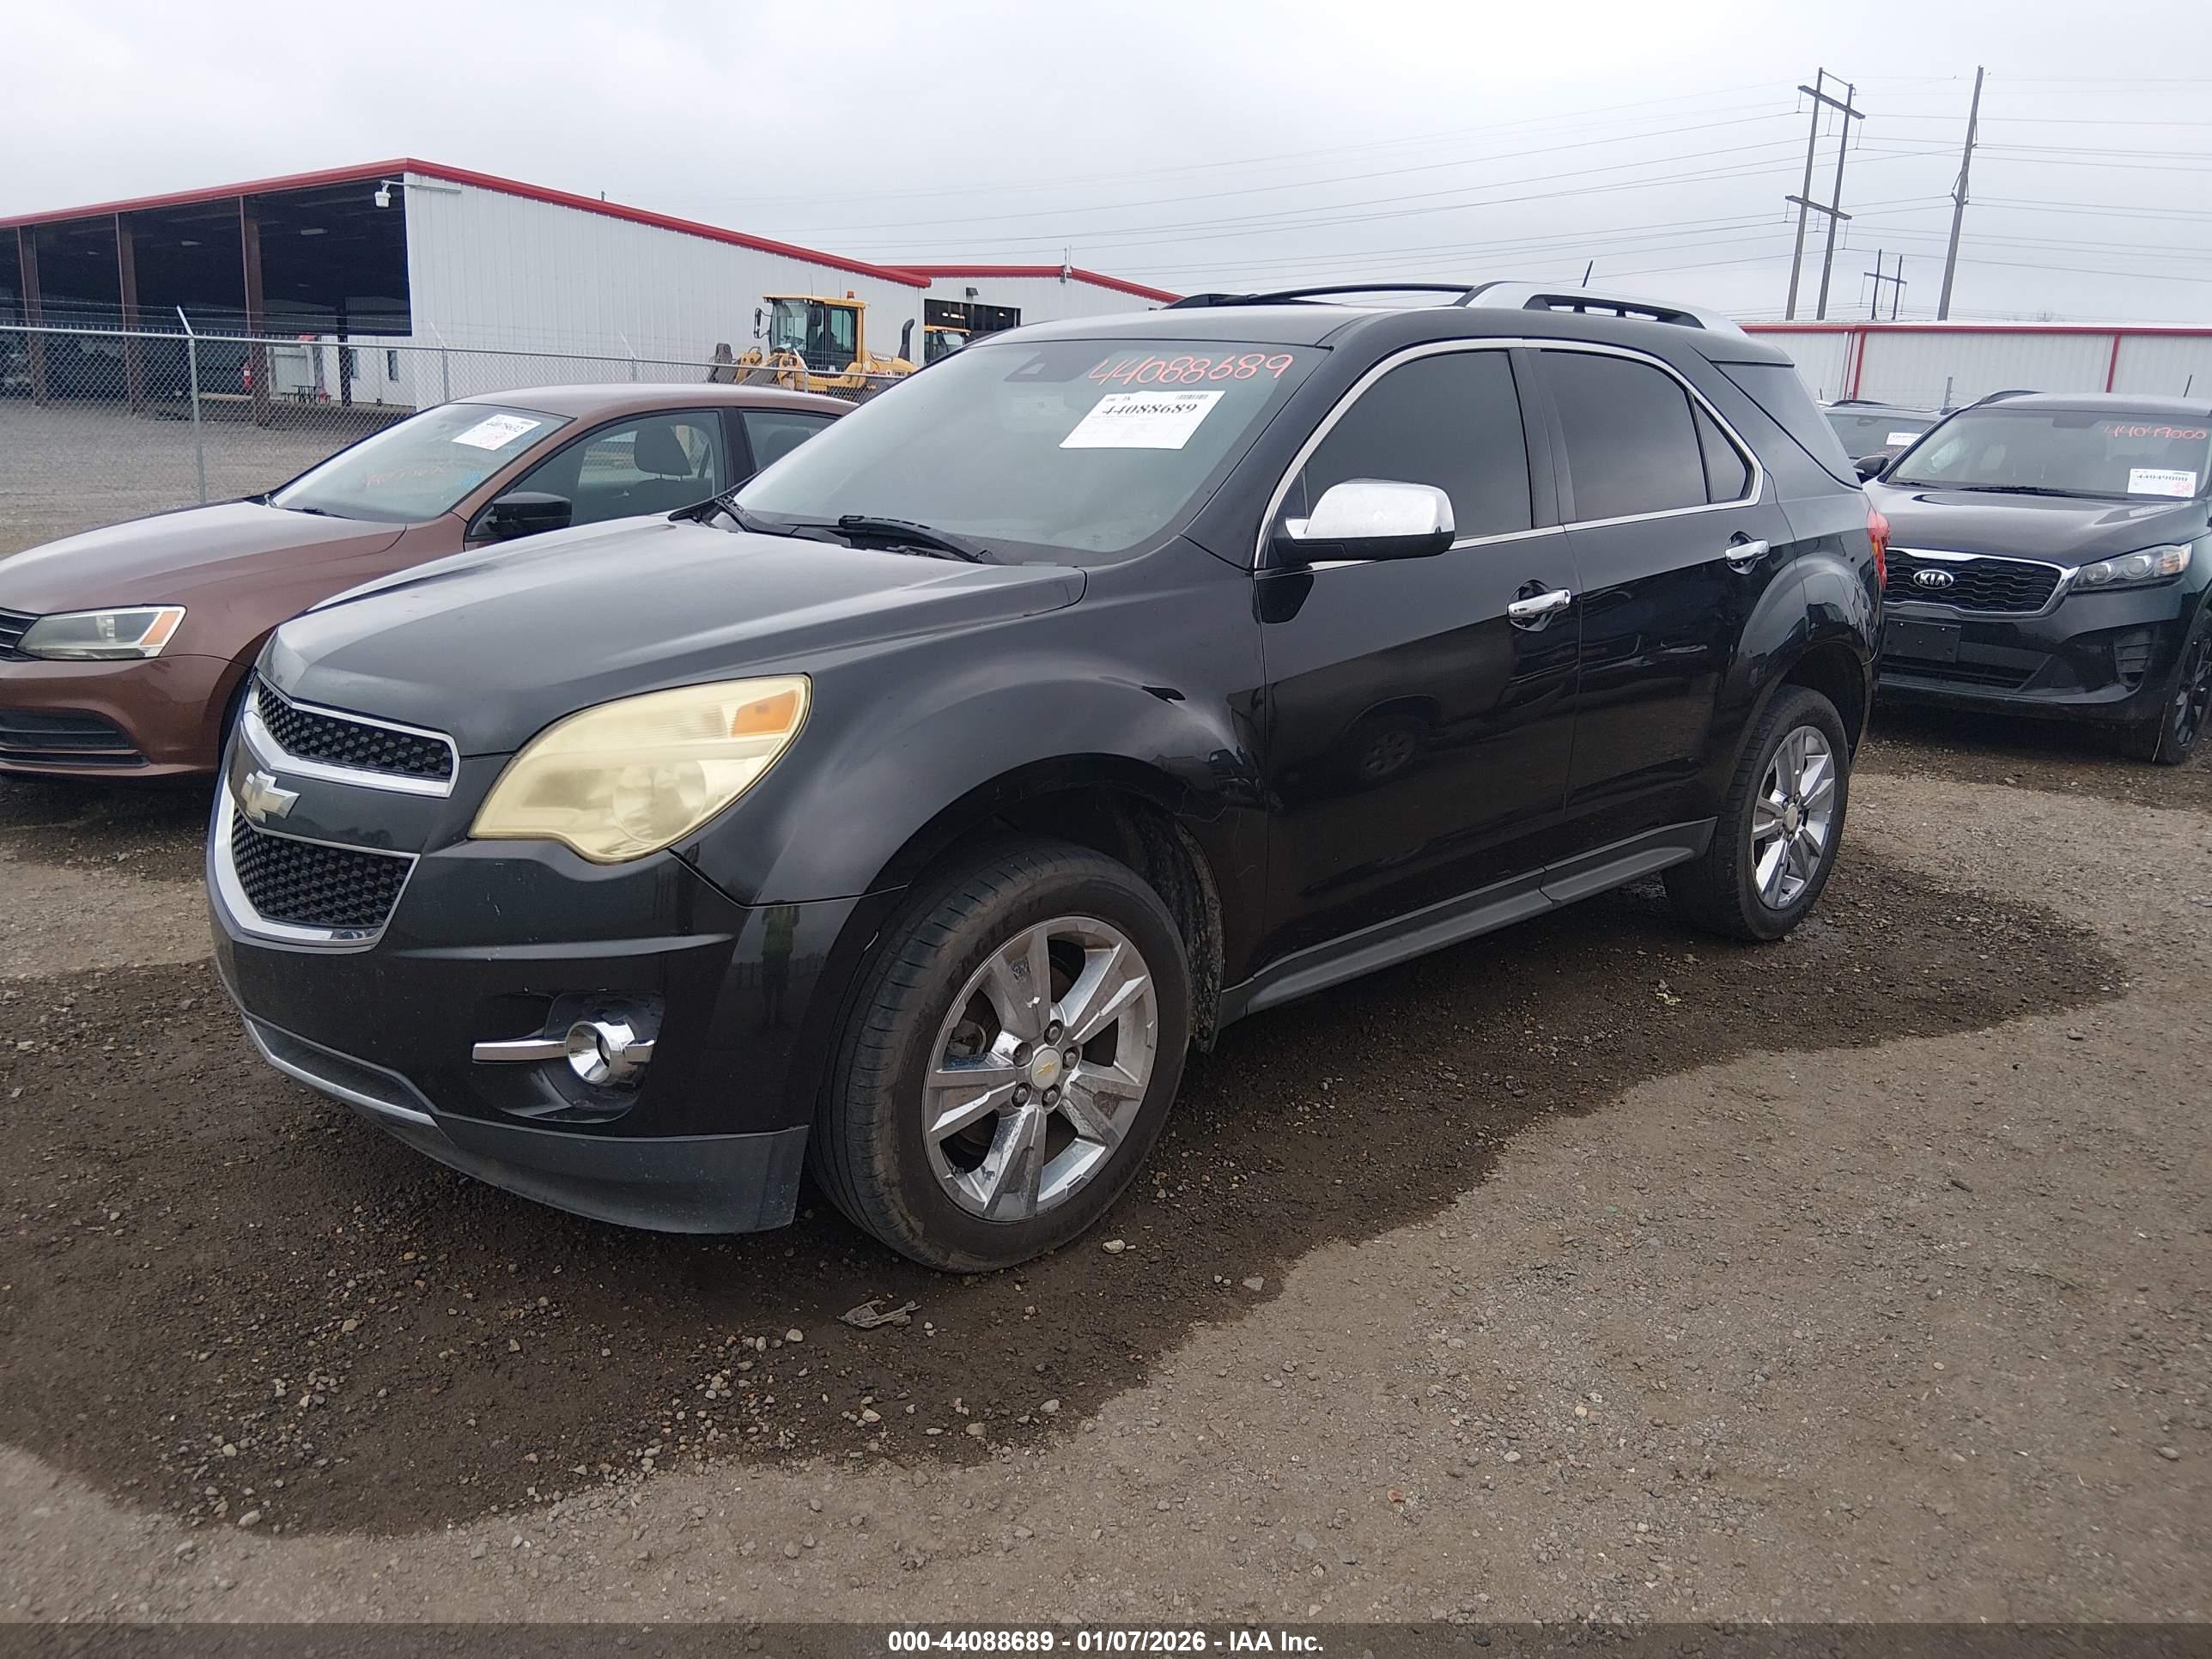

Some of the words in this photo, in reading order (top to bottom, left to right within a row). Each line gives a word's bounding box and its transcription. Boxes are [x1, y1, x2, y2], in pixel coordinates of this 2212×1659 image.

[1088, 353, 1294, 386] 44088689
[1102, 403, 1198, 416] 44088689
[1919, 573, 1946, 586] KIA
